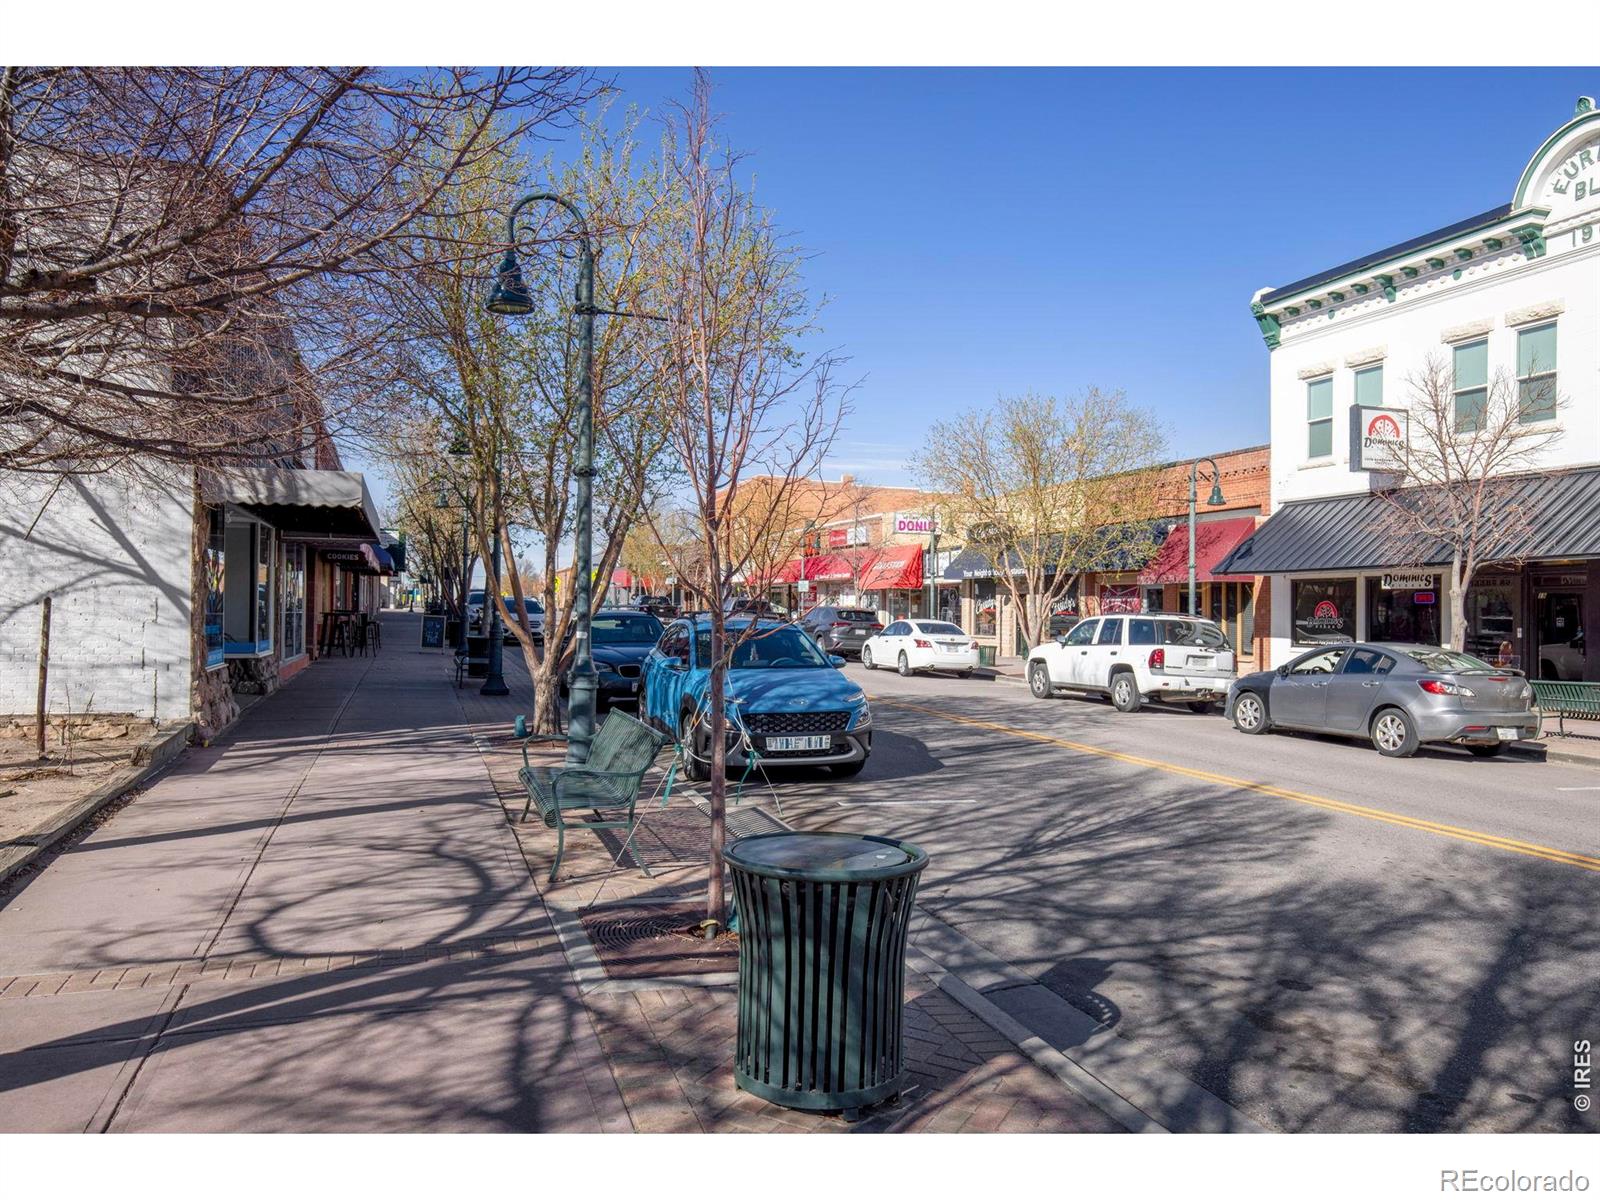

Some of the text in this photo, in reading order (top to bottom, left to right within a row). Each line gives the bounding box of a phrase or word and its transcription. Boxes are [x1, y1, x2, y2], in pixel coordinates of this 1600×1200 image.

[1553, 148, 1600, 195] EUR
[1572, 225, 1600, 247] 19
[327, 552, 359, 560] COOKIES
